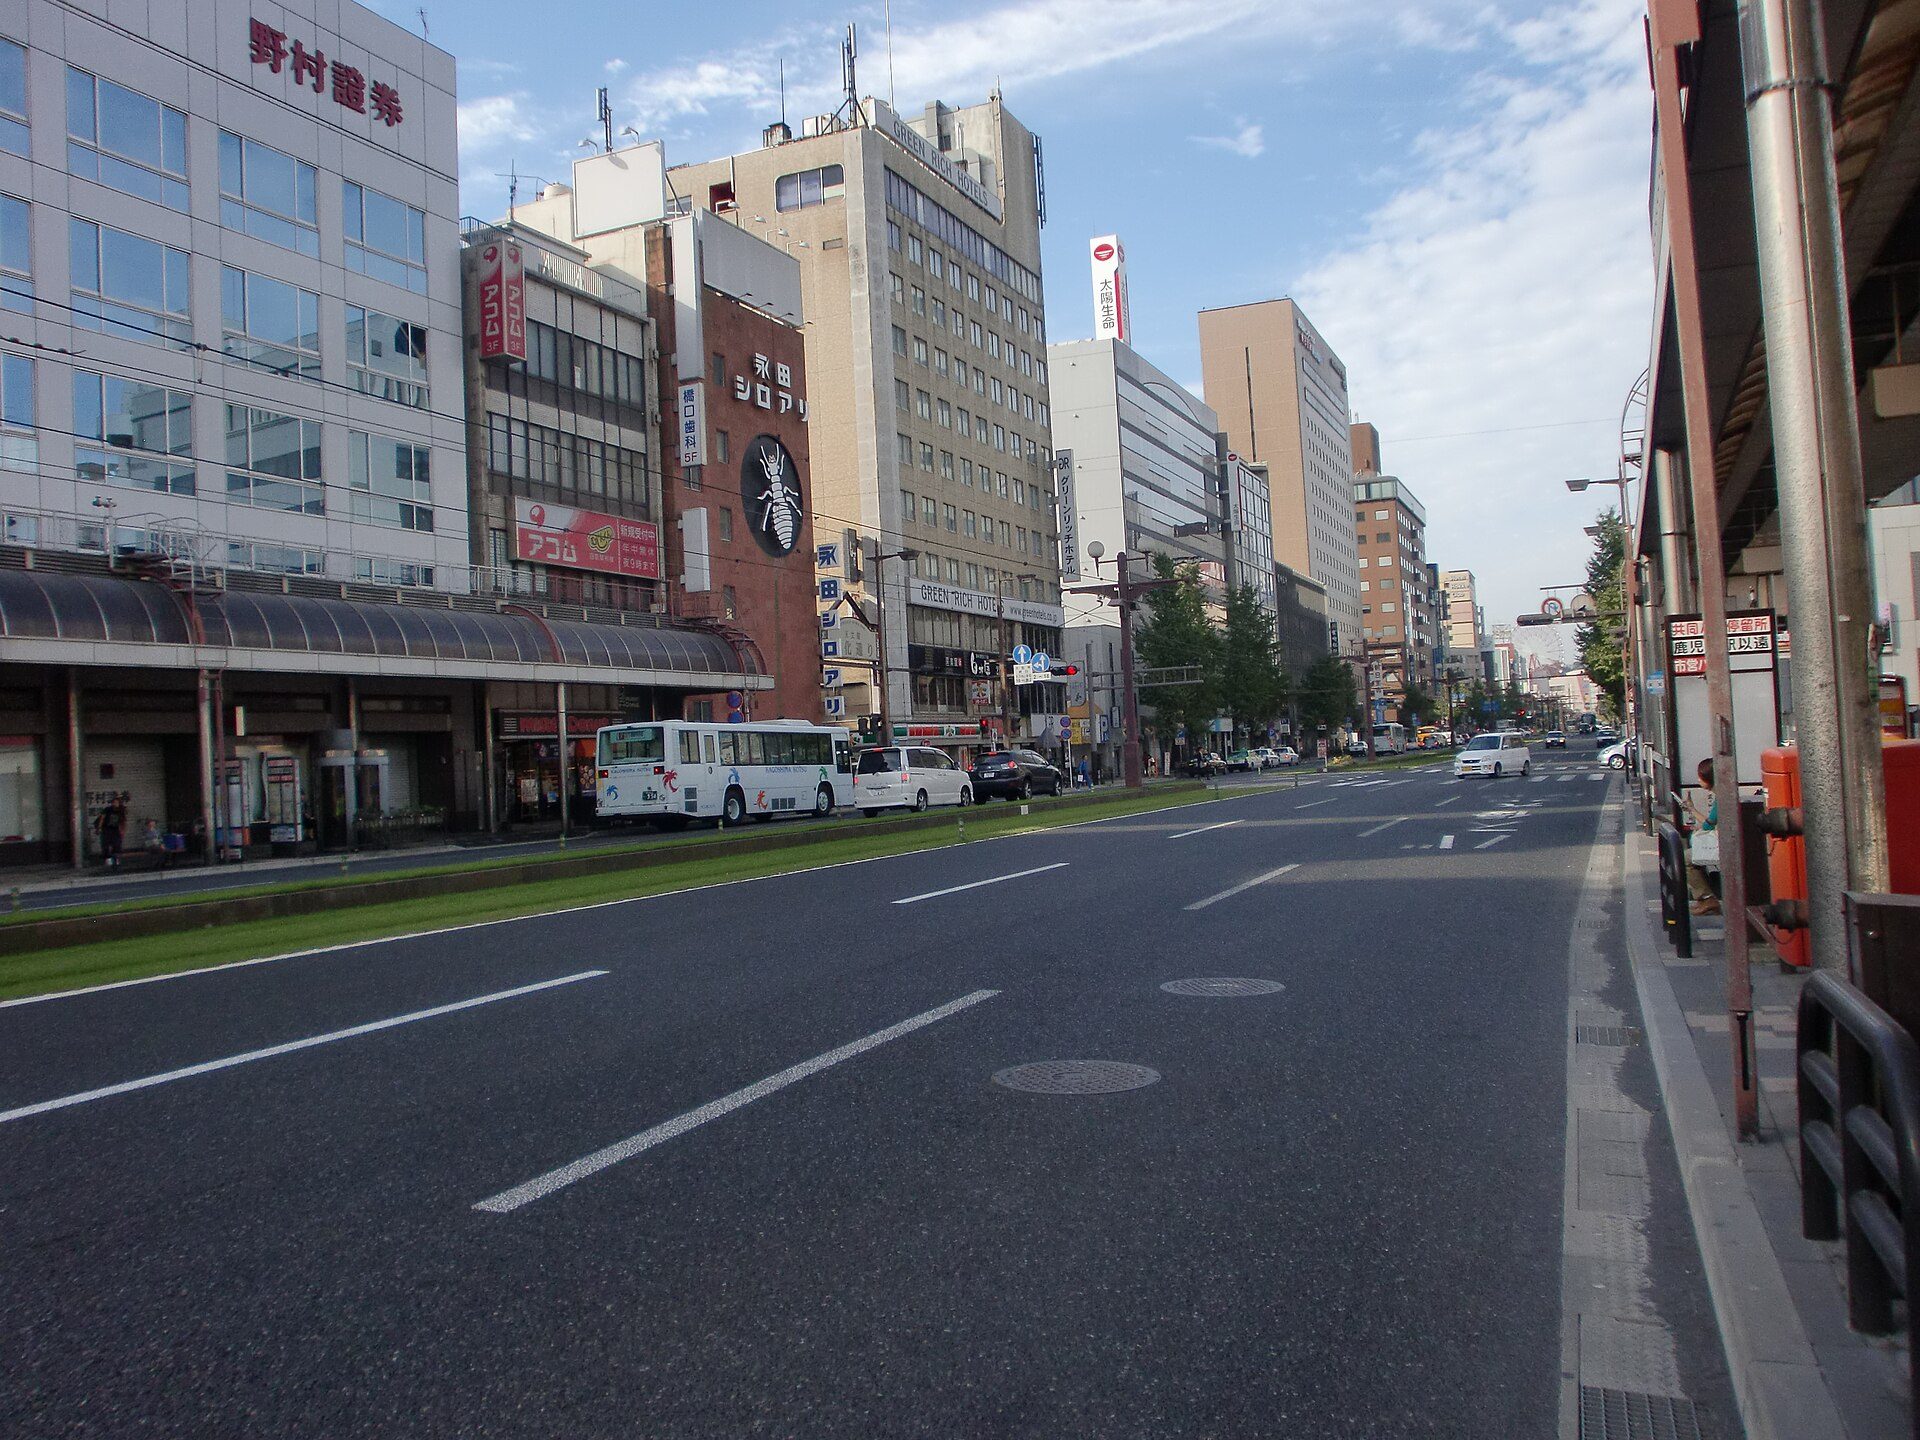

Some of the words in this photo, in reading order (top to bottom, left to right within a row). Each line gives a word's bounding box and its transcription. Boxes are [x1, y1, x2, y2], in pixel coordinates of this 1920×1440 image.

[250, 17, 403, 127] 野村證券
[893, 121, 926, 159] GREEN
[931, 146, 953, 177] RICH
[957, 168, 989, 207] HOTELS
[484, 283, 499, 337] アコム
[508, 284, 521, 338] アコム
[1100, 279, 1116, 329] 太陽生命
[486, 340, 499, 352] 3F
[511, 341, 521, 352] 3F
[754, 352, 791, 389] 永田
[683, 388, 697, 448] 橋口歯科
[735, 375, 809, 422] シロアリ
[684, 451, 698, 463] 5F
[528, 533, 577, 563] アコム
[620, 524, 656, 541] 新規受付中
[1061, 475, 1076, 575] グリーンリッチホテル
[622, 557, 655, 572] 夜9時まで
[920, 584, 949, 604] GREEN
[954, 592, 973, 608] RICH
[978, 595, 1005, 614] HOTES
[818, 545, 841, 714] 永田シロアリ
